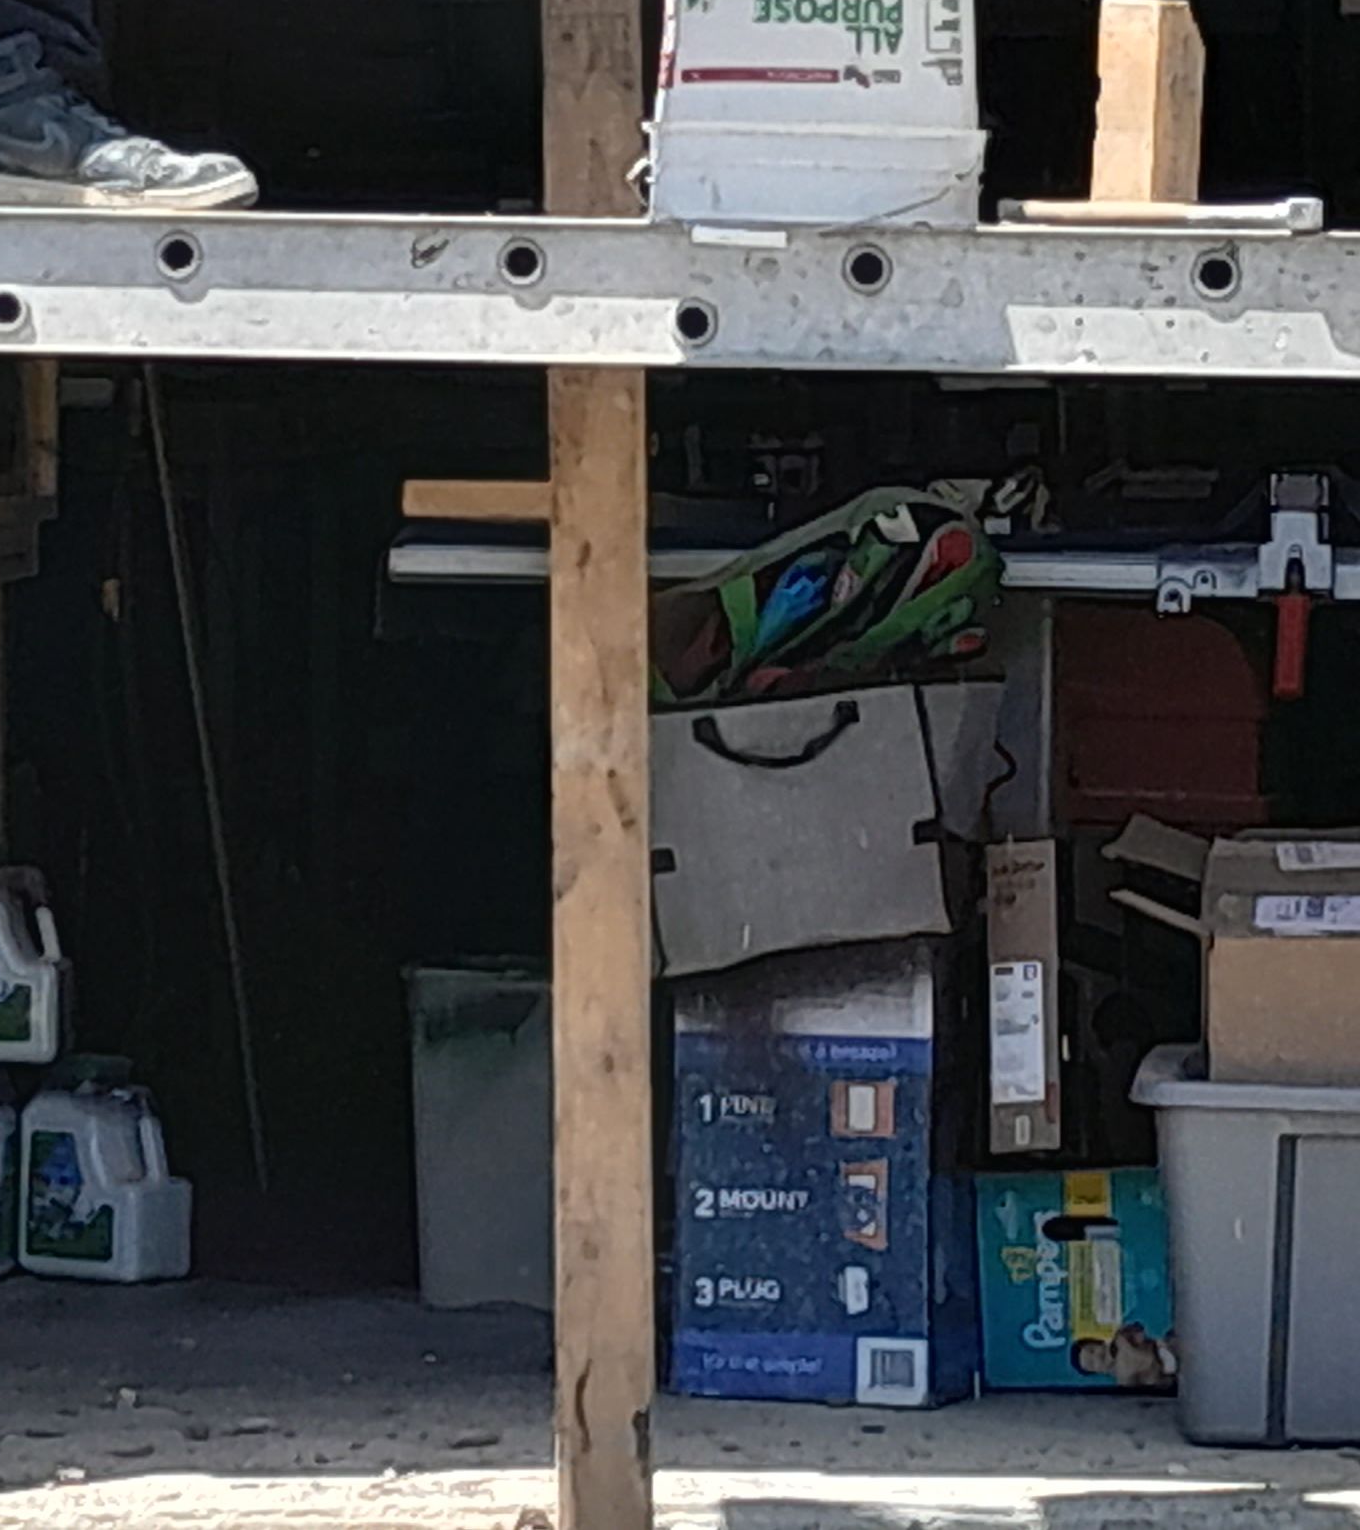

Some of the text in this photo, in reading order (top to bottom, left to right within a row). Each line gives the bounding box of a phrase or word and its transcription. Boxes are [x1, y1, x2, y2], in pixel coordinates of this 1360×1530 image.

[845, 26, 903, 55] ALL
[698, 1093, 713, 1122] 1
[694, 1188, 810, 1218] 2 MOUNT
[694, 1276, 781, 1307] 3 PLUG
[1022, 1208, 1068, 1349] Pampes
